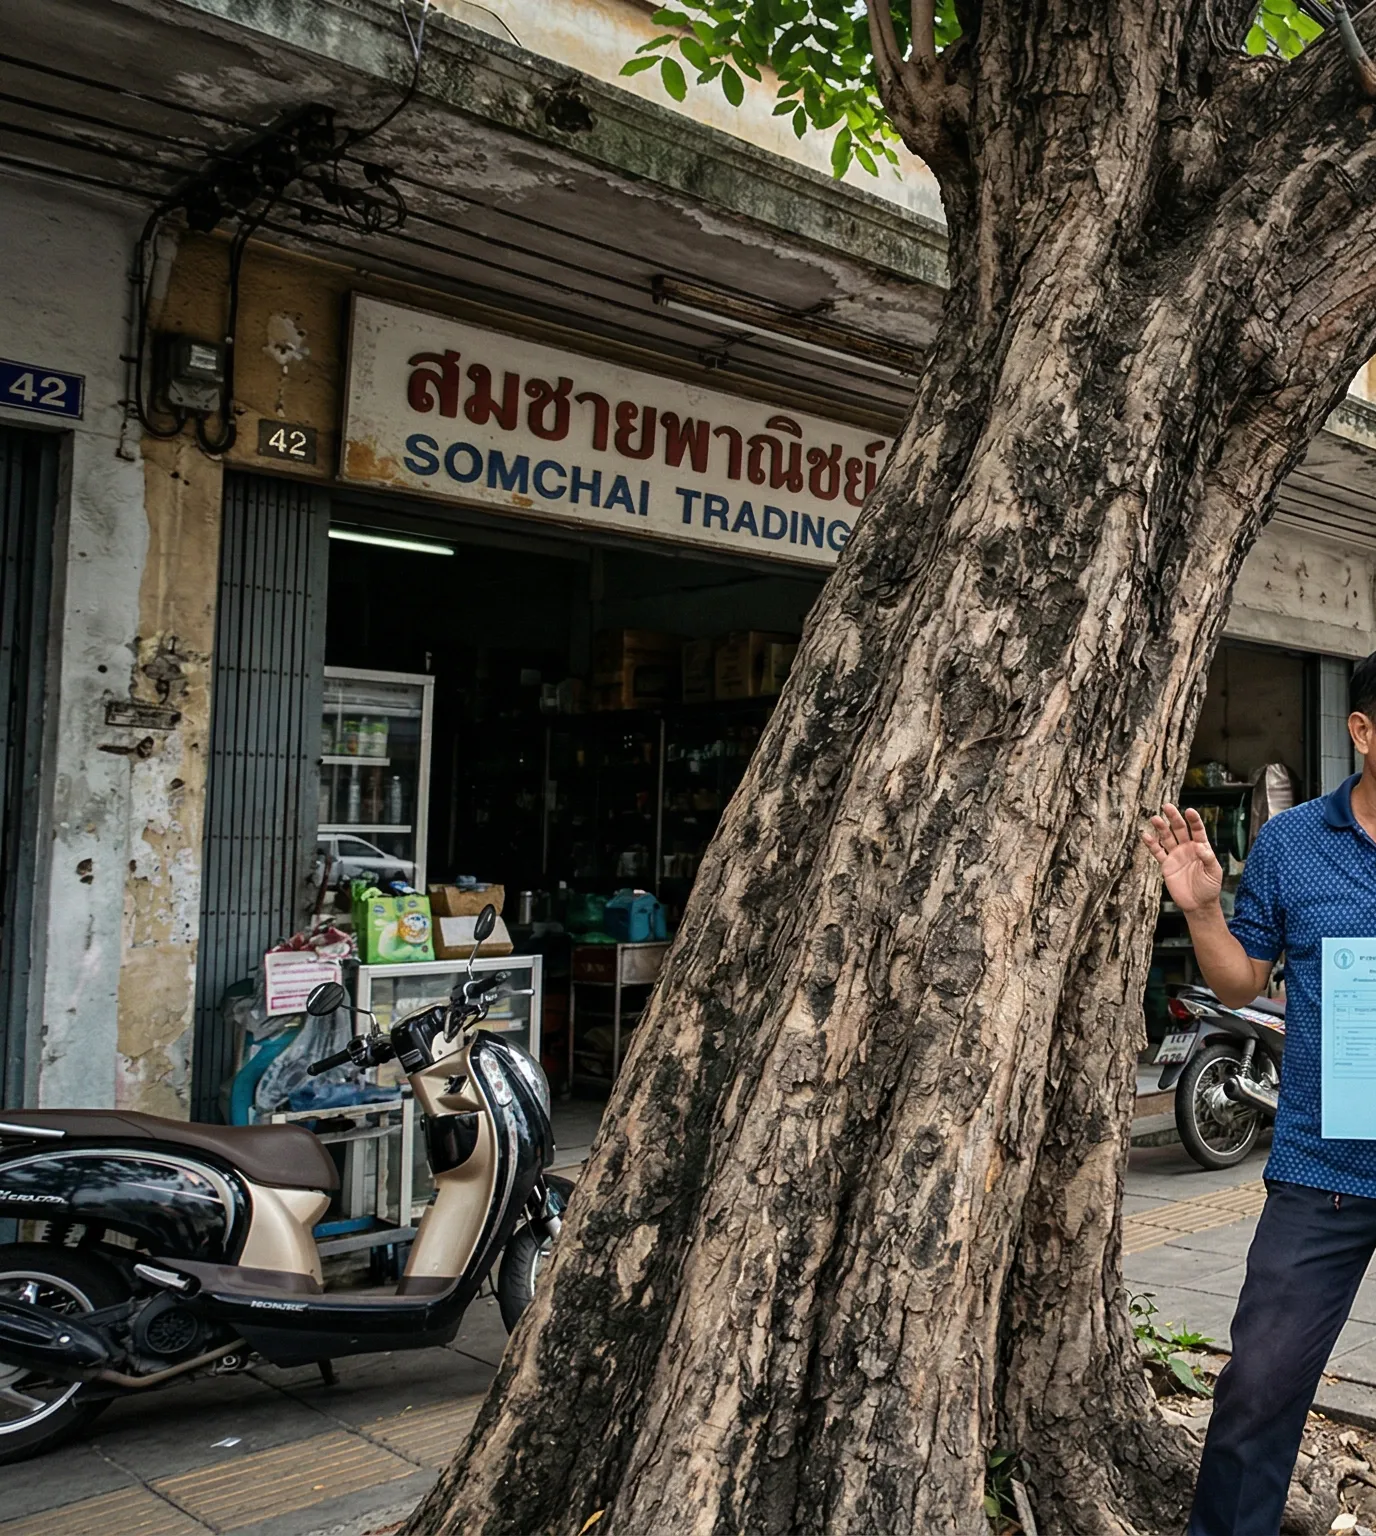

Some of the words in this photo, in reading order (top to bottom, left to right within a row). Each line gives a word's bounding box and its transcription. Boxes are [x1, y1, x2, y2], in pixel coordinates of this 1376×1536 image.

[9, 372, 67, 408] 42
[407, 349, 886, 508] สมชายพาณิชย์
[269, 429, 306, 456] 42
[403, 433, 650, 516] SOMCHAI
[675, 486, 852, 552] TRADING
